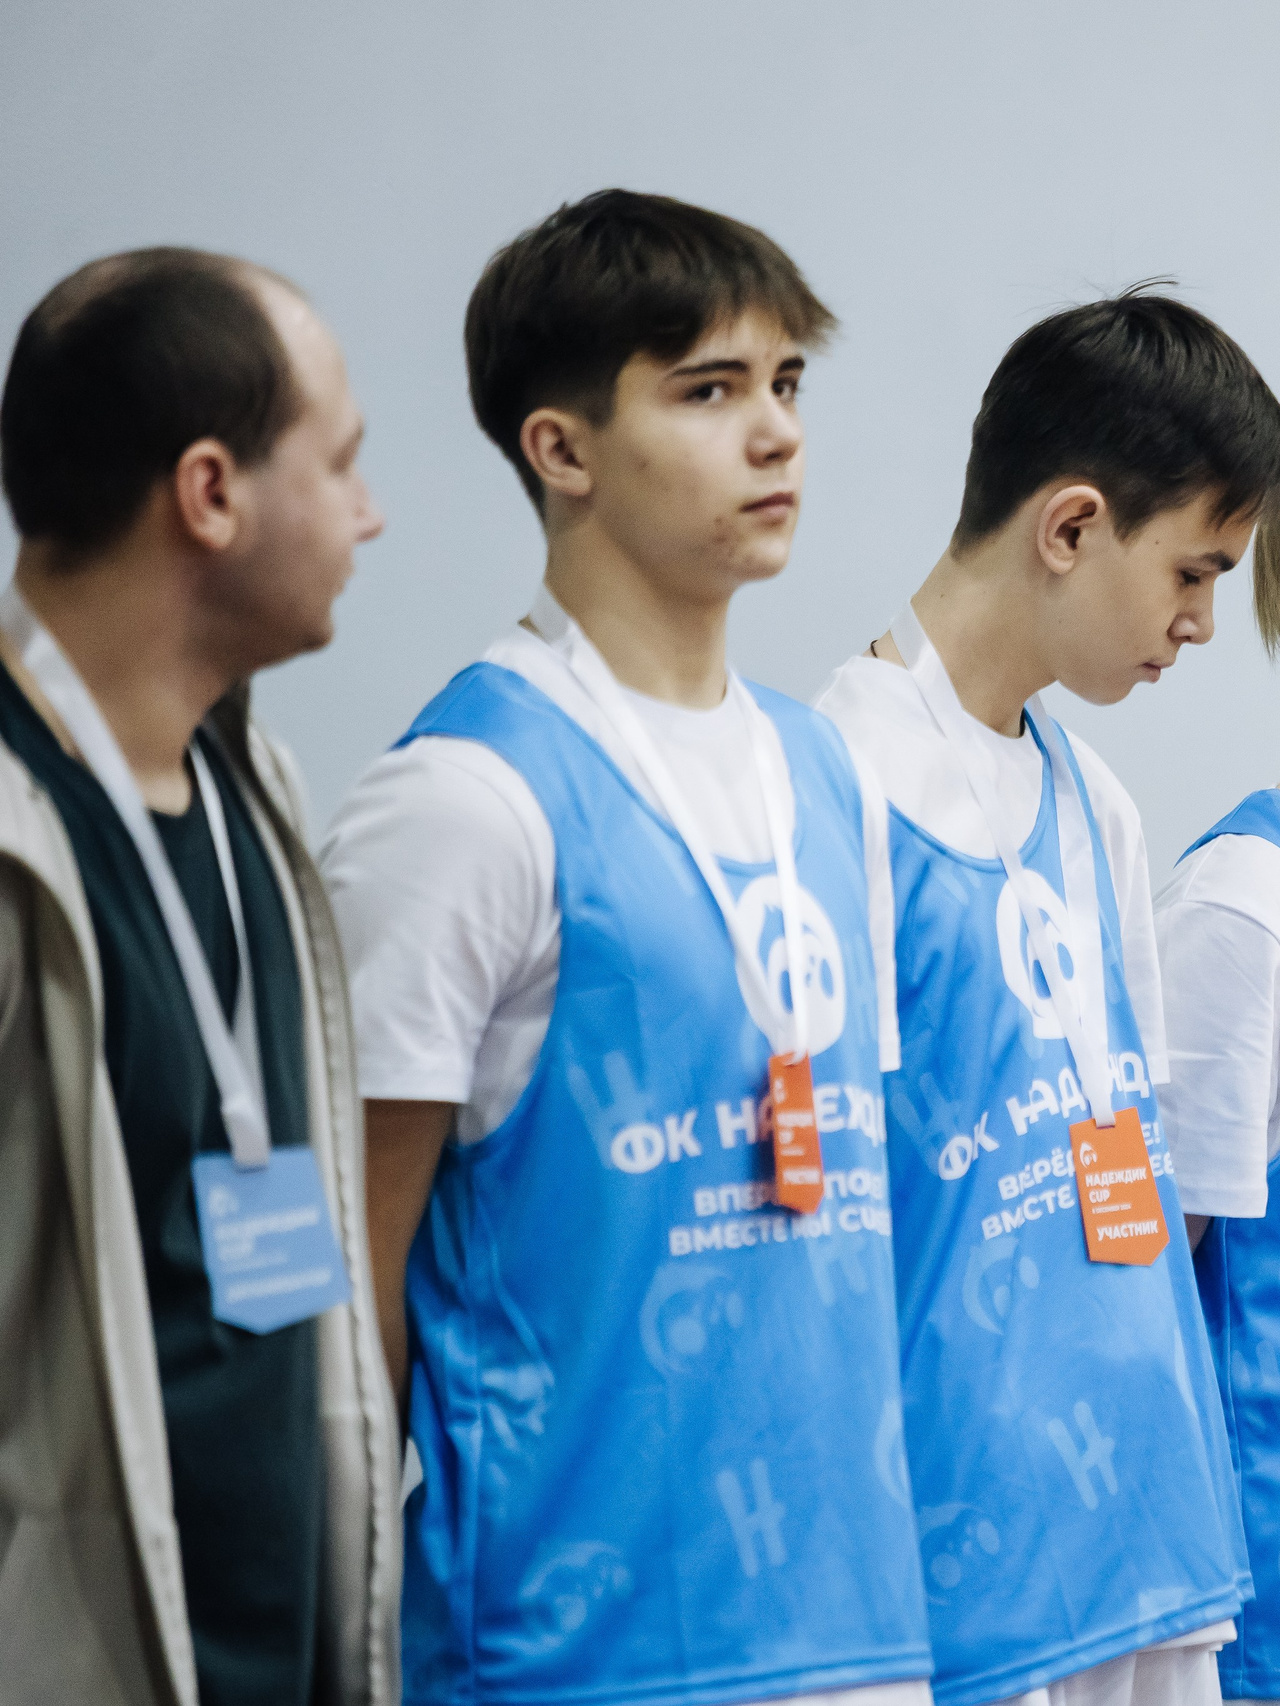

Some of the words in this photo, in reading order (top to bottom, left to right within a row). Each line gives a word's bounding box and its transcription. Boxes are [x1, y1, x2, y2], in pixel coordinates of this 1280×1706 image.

[610, 1107, 702, 1174] ФК
[937, 1110, 1000, 1181] ФК
[1084, 1167, 1148, 1188] НАДЕЖДИК
[1088, 1189, 1111, 1203] CUP
[1096, 1219, 1159, 1241] УЧАСТНИК
